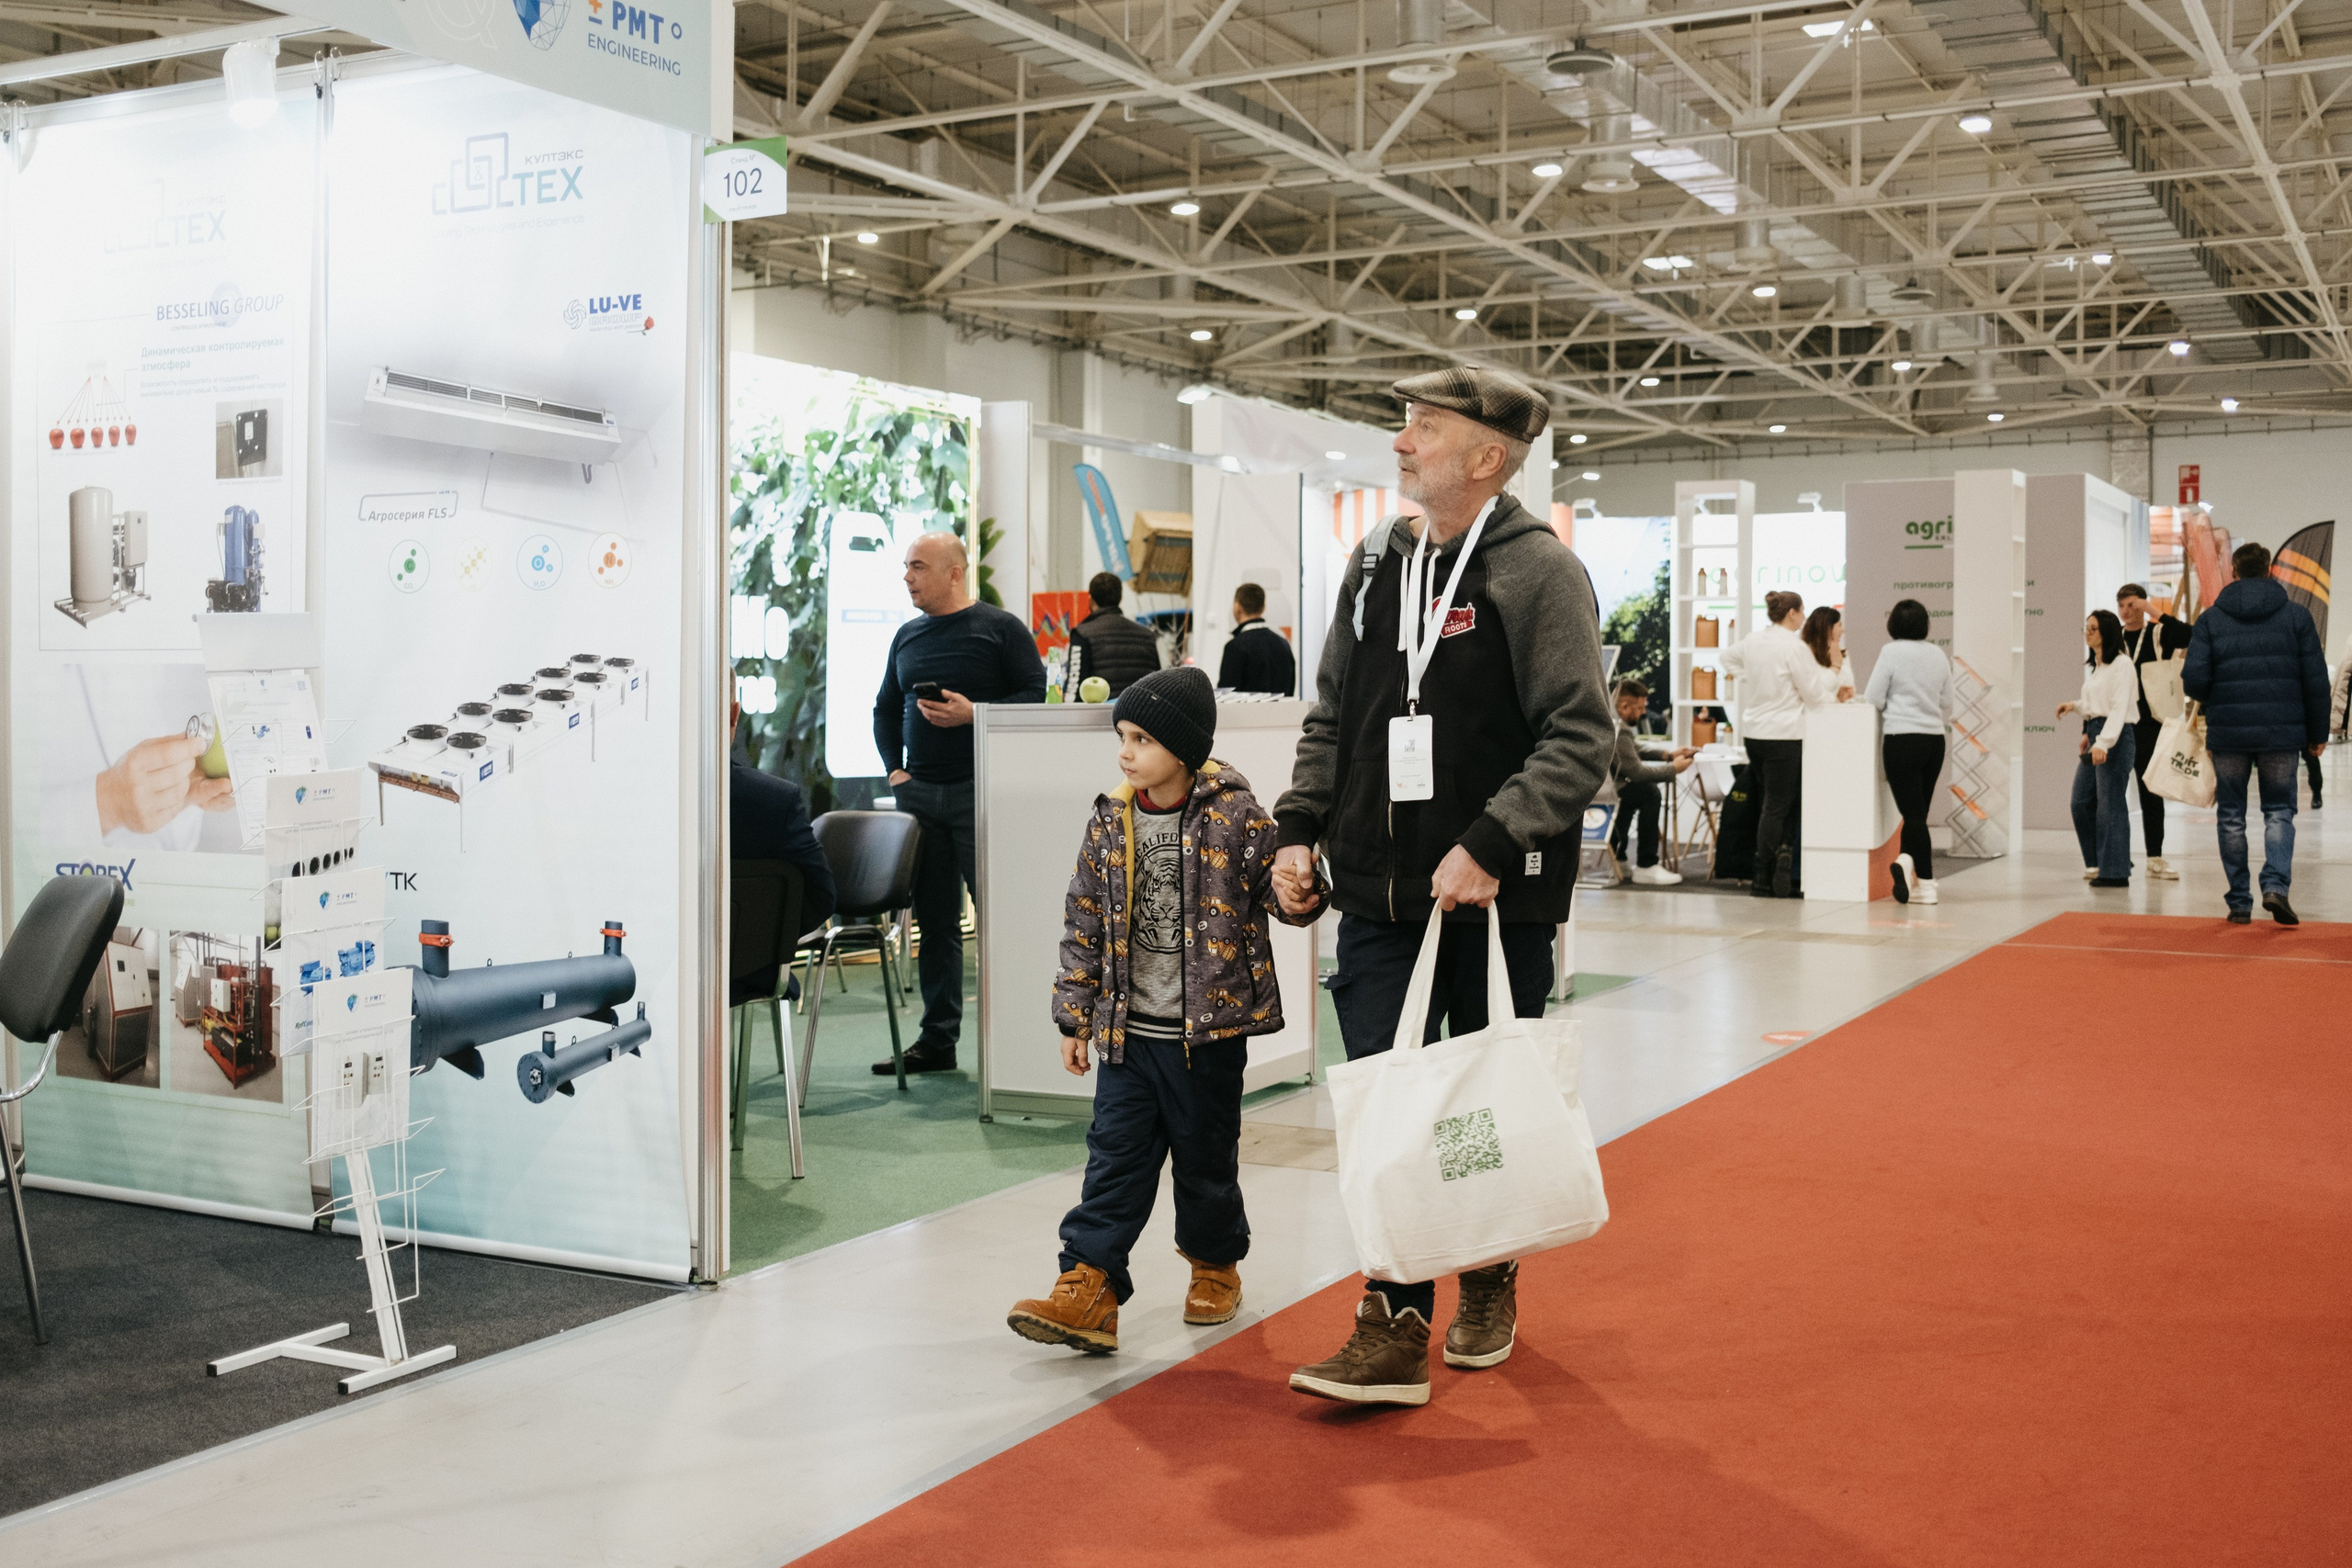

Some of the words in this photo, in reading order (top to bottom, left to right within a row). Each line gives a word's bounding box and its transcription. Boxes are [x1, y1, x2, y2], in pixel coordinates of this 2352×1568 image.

[612, 1, 664, 44] PMT
[587, 33, 682, 76] ENGINEERING
[723, 167, 763, 197] 102
[156, 299, 230, 321] BESSELING
[234, 293, 284, 314] GROUP
[589, 293, 642, 314] LU-VE
[141, 342, 207, 360] Динамическая
[209, 337, 285, 353] контролируемая
[141, 359, 191, 373] атмосфера
[368, 511, 425, 524] Агросерия
[427, 507, 447, 519] FLS
[1894, 581, 1954, 592] противогр
[385, 872, 419, 892] TK
